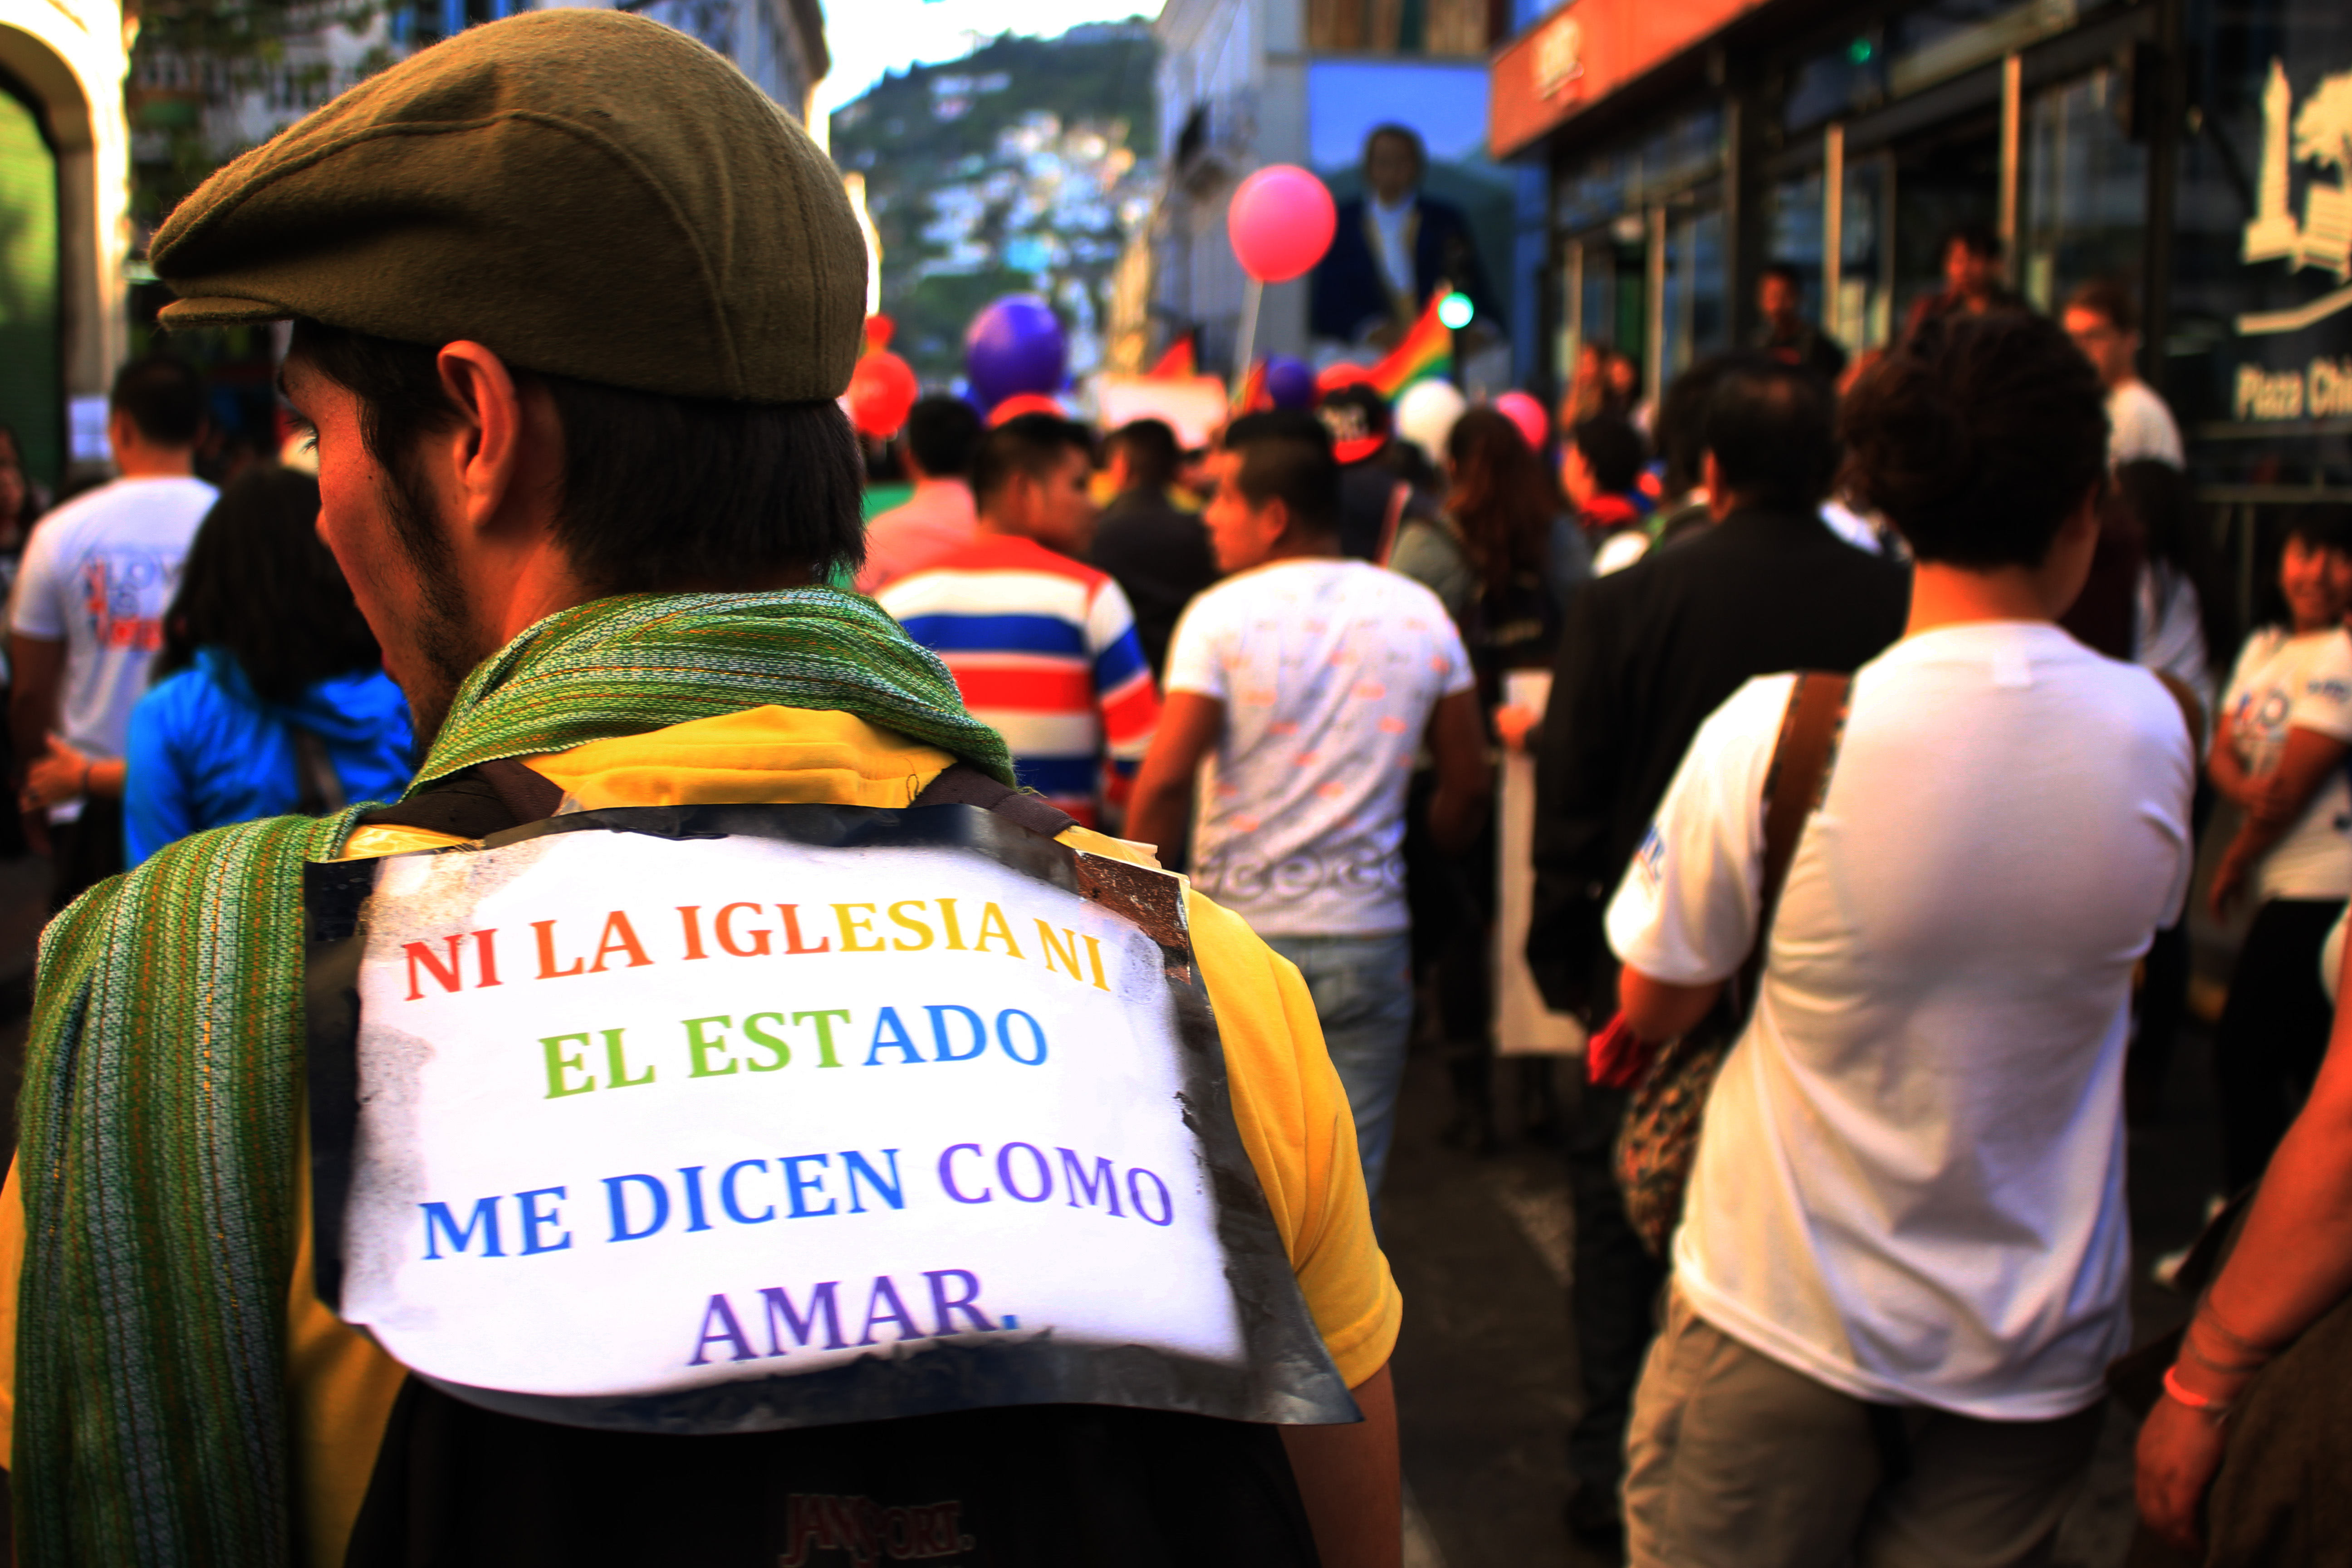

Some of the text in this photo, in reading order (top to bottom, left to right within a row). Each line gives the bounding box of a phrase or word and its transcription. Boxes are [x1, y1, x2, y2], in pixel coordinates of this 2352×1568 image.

[2236, 364, 2303, 420] Plaza
[403, 897, 1111, 1001] NI LA IGLESIA NI
[539, 1004, 1049, 1100] EL ESTADO
[417, 1141, 1175, 1261] ME DICEN COMO
[686, 1268, 1019, 1367] AMAR.
